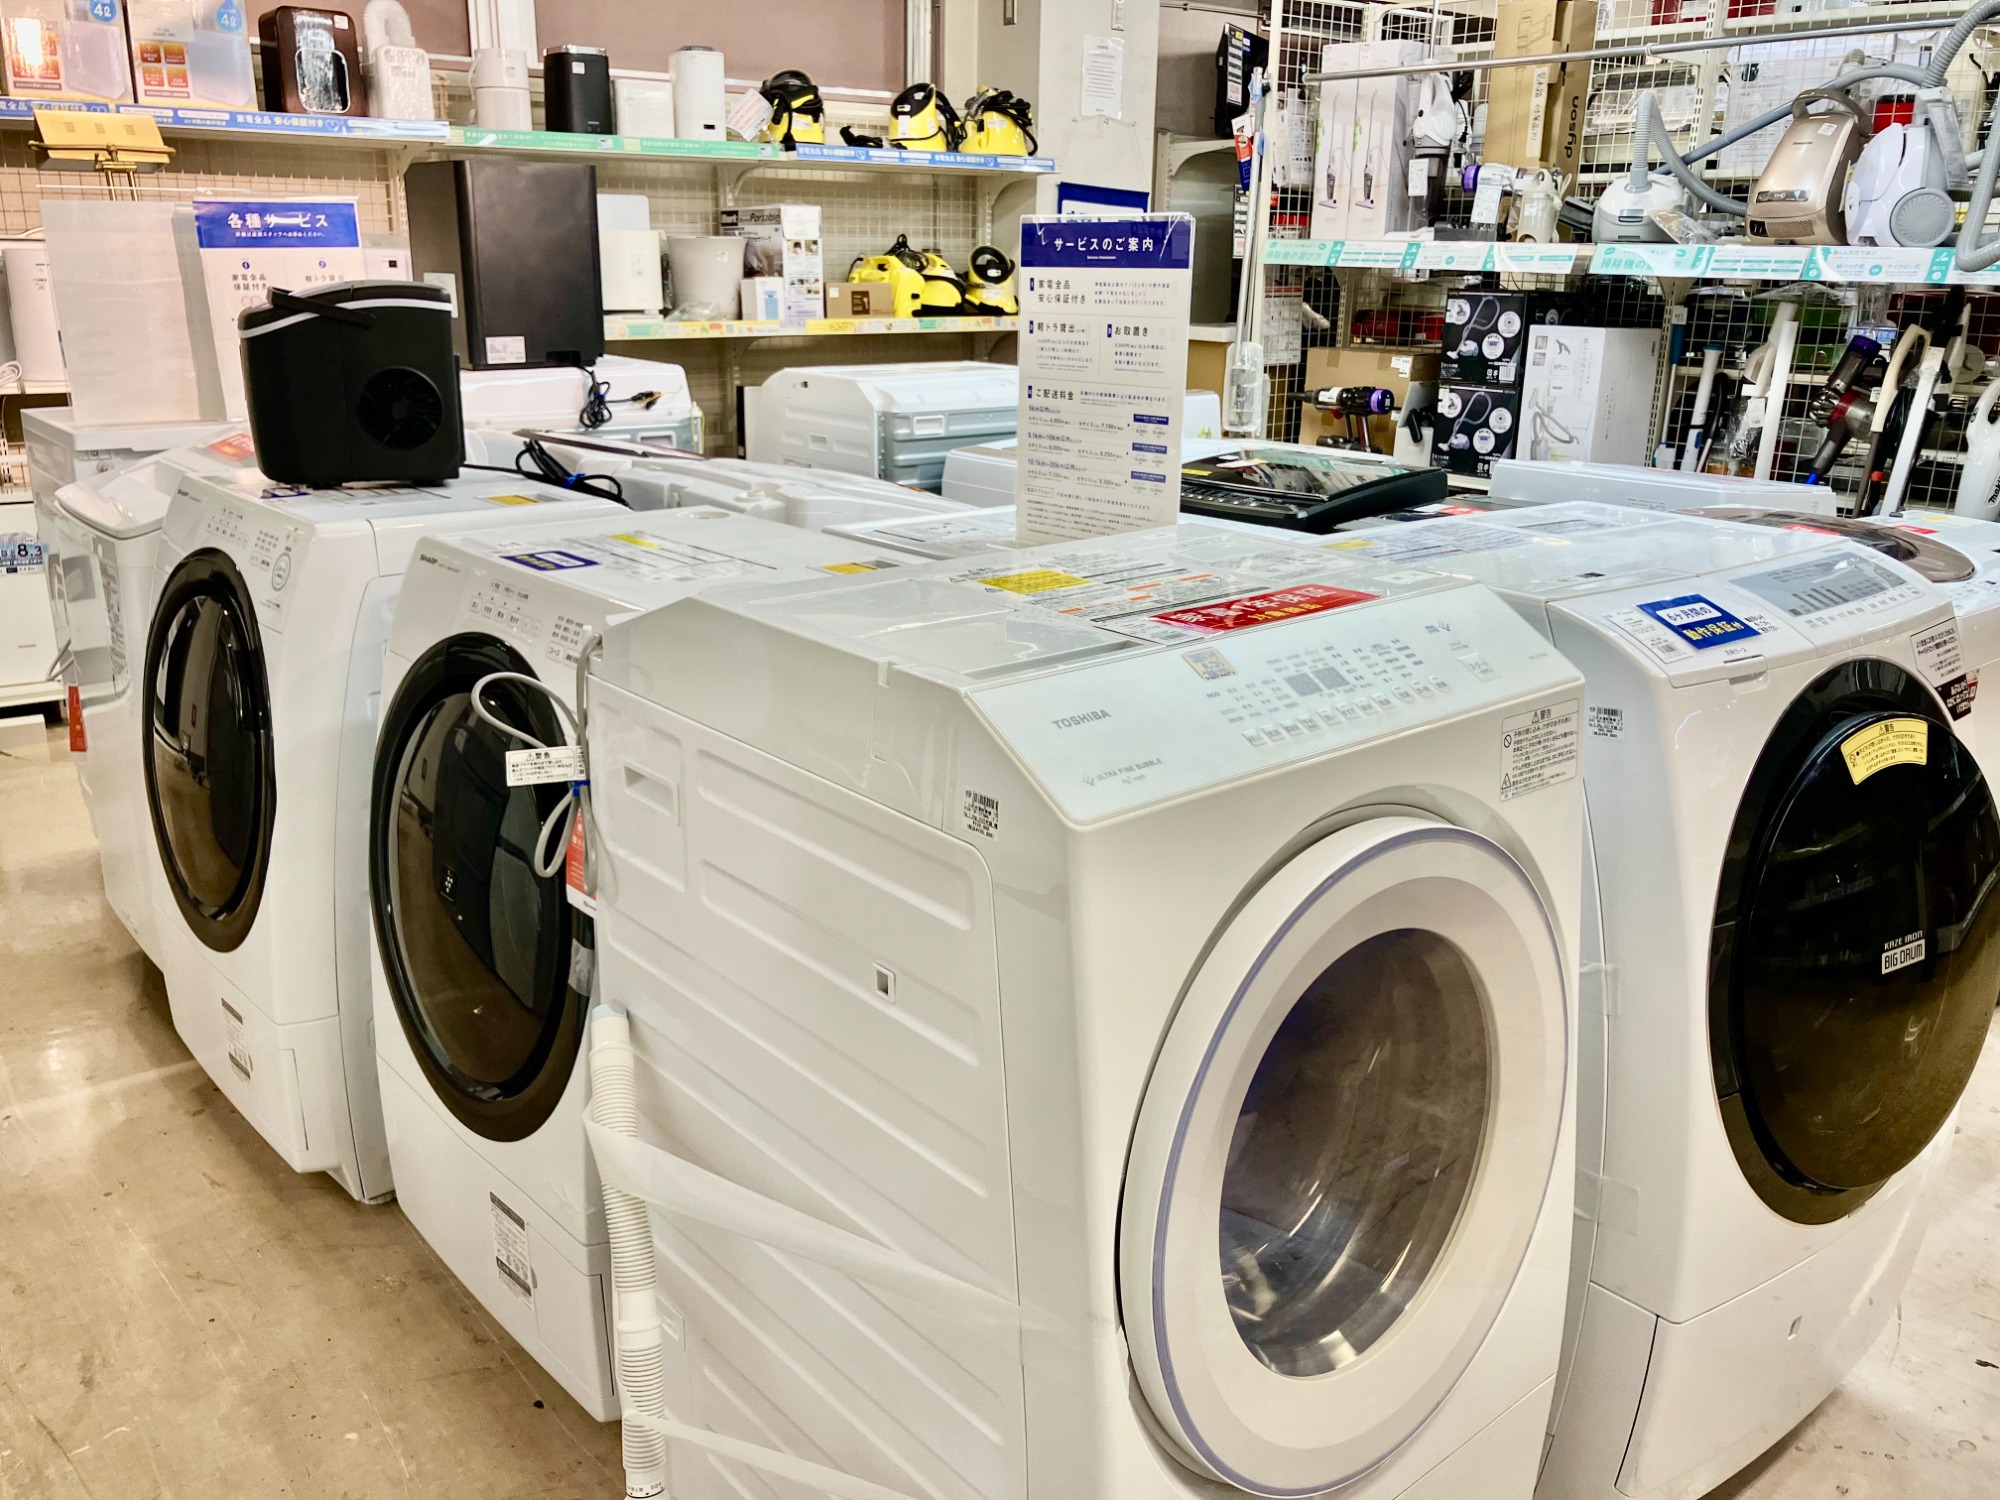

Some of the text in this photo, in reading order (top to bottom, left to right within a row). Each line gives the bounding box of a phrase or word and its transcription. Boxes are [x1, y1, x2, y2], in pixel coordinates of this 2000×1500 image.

[1564, 96, 1579, 158] dyson
[228, 213, 328, 229] 各種サービス
[750, 212, 781, 223] Portable
[1054, 237, 1154, 252] サービスのご案内
[232, 274, 267, 282] 家電全品
[233, 283, 267, 291] 保証付き
[1039, 279, 1071, 290] 家電全品
[1038, 294, 1085, 304] 安心保証付き
[1037, 322, 1076, 333] 軽トラ貸出
[1115, 326, 1148, 337] お取置き
[1036, 389, 1075, 401] ご配送料金
[420, 554, 439, 565] SHARP
[1248, 603, 1322, 620] 対象商品
[1682, 620, 1744, 641] 動作保証付
[1051, 709, 1112, 730] TOSHIBA
[1884, 723, 1895, 733] 警告
[535, 752, 551, 760] 警告
[1096, 770, 1119, 781] ULTRA
[1118, 765, 1136, 775] FINE
[1134, 758, 1163, 770] BUBBLE
[1884, 930, 1923, 951] KAZE IRON
[1884, 943, 1923, 970] BIG DRUM
